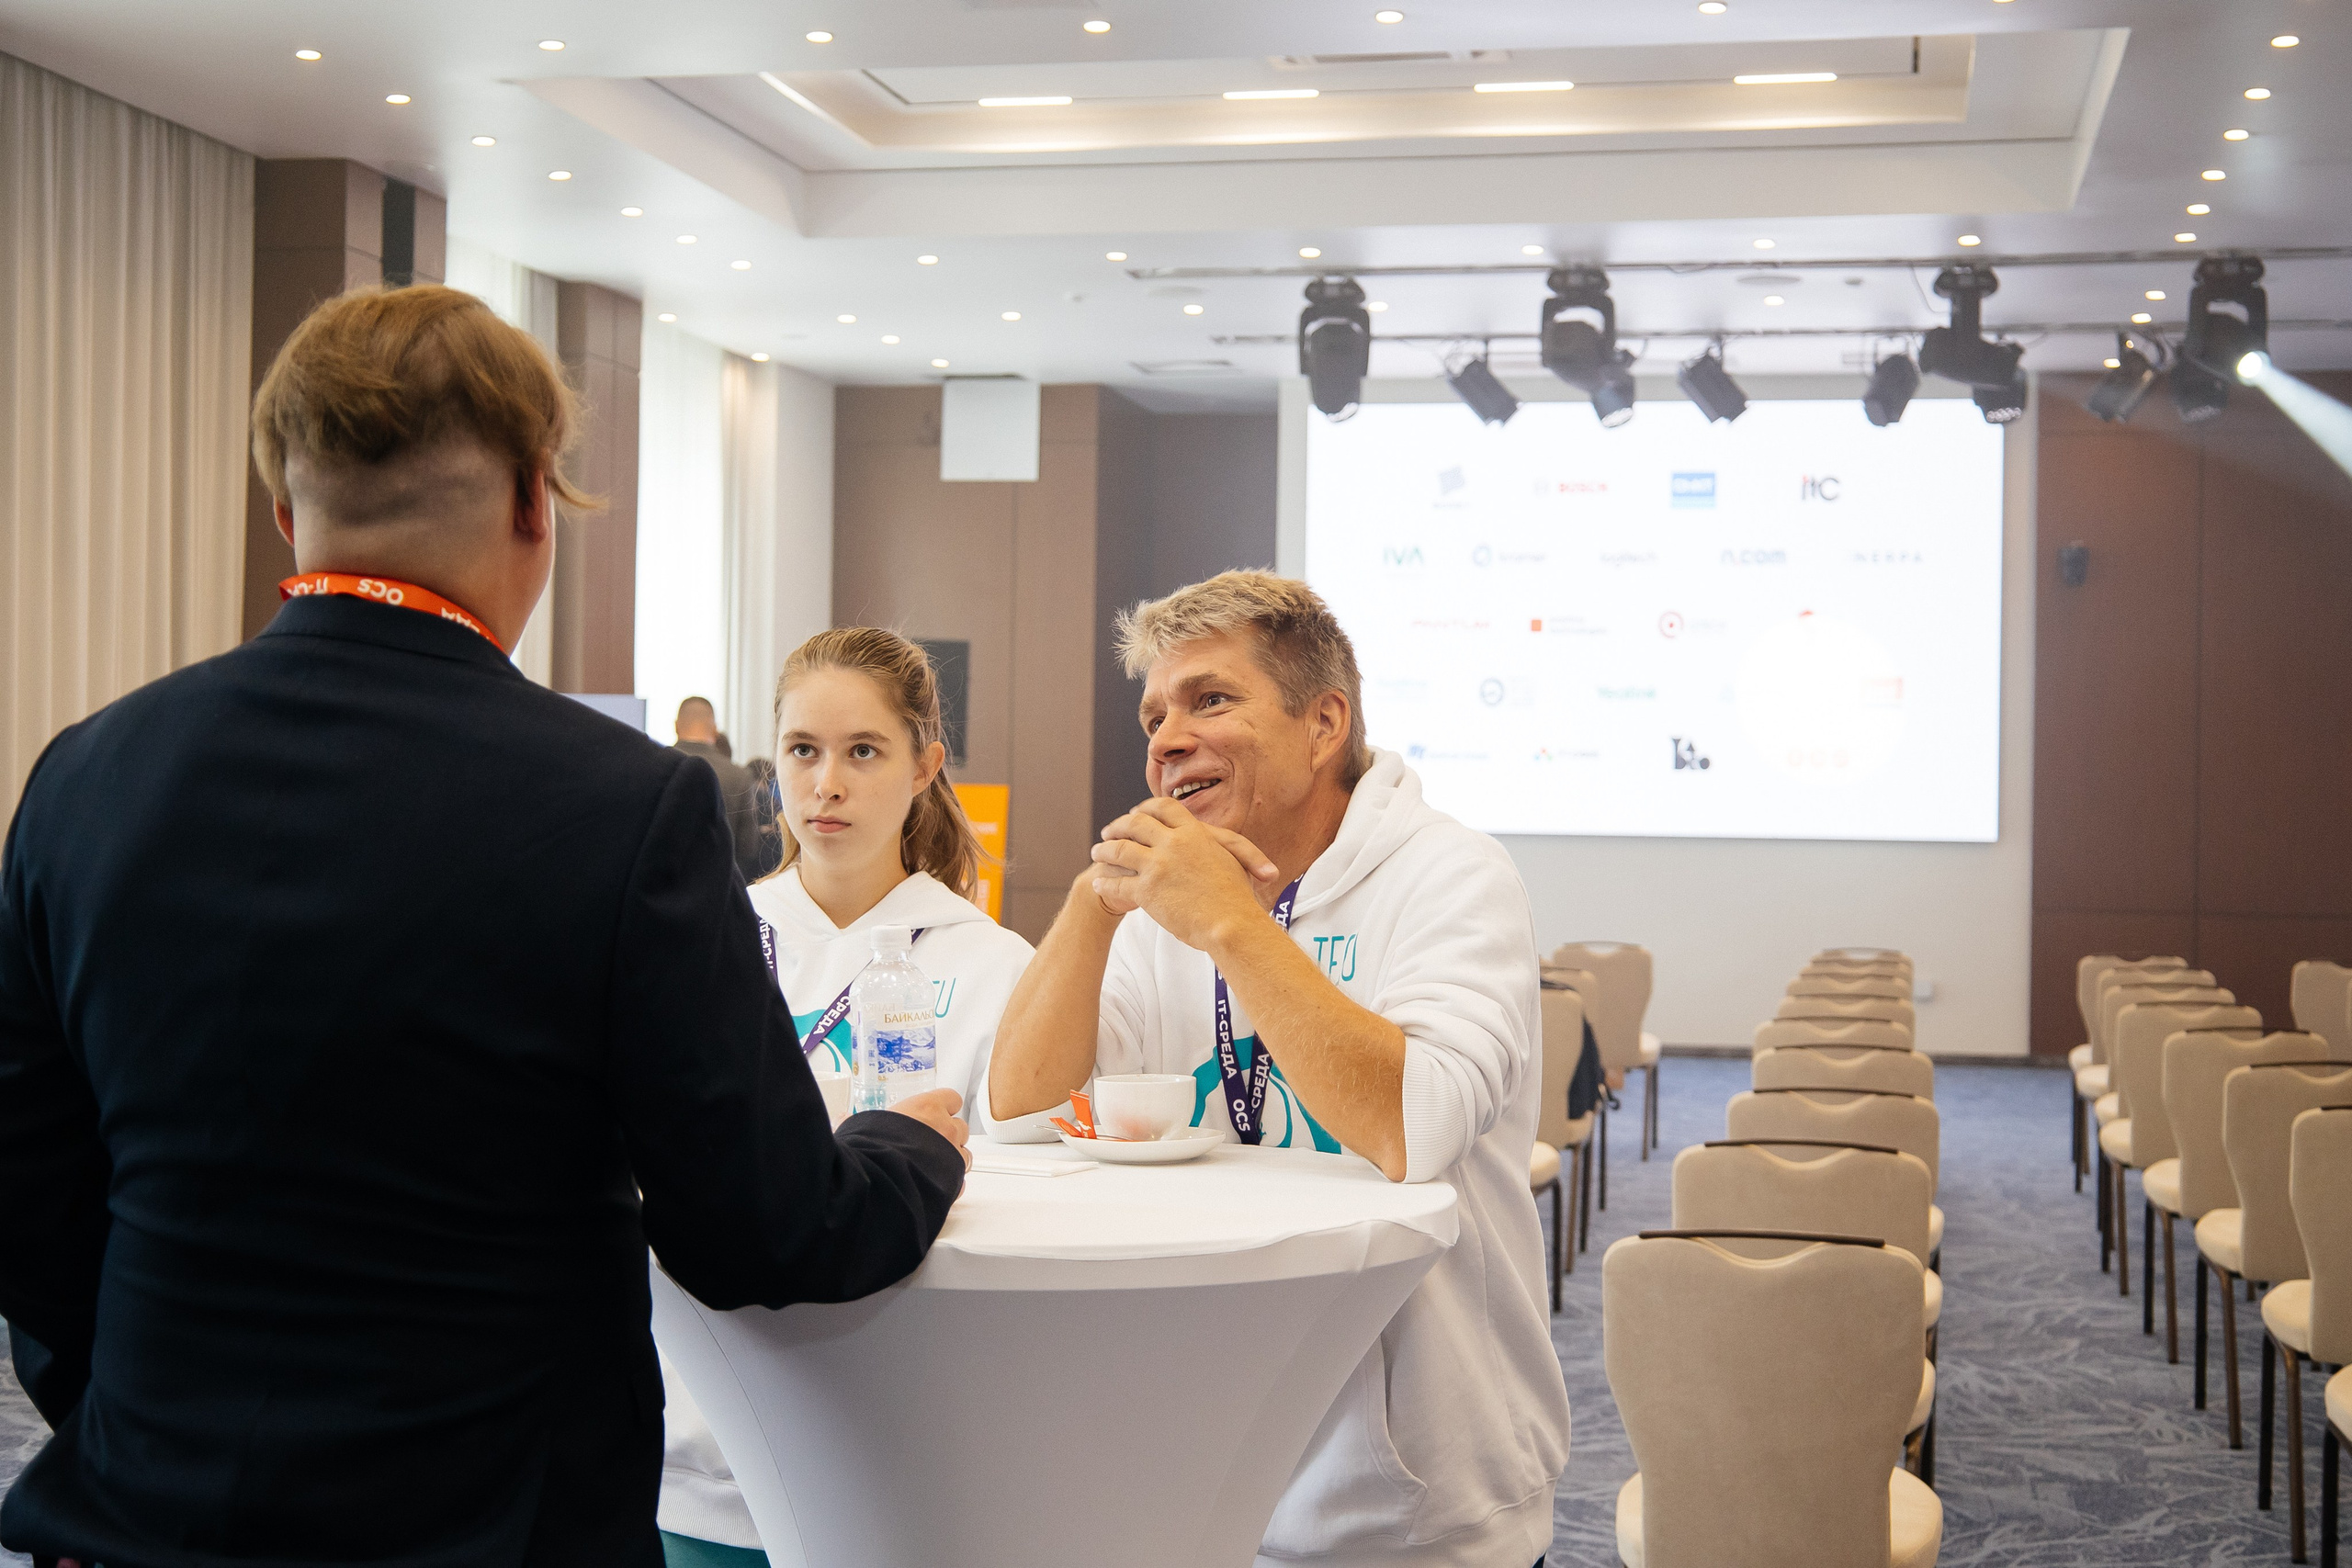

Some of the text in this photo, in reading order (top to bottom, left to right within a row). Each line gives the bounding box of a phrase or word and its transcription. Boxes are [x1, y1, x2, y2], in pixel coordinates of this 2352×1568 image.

[356, 578, 403, 605] OCS
[1217, 999, 1238, 1079] IT-СРЕДА
[1232, 1099, 1251, 1133] OCS
